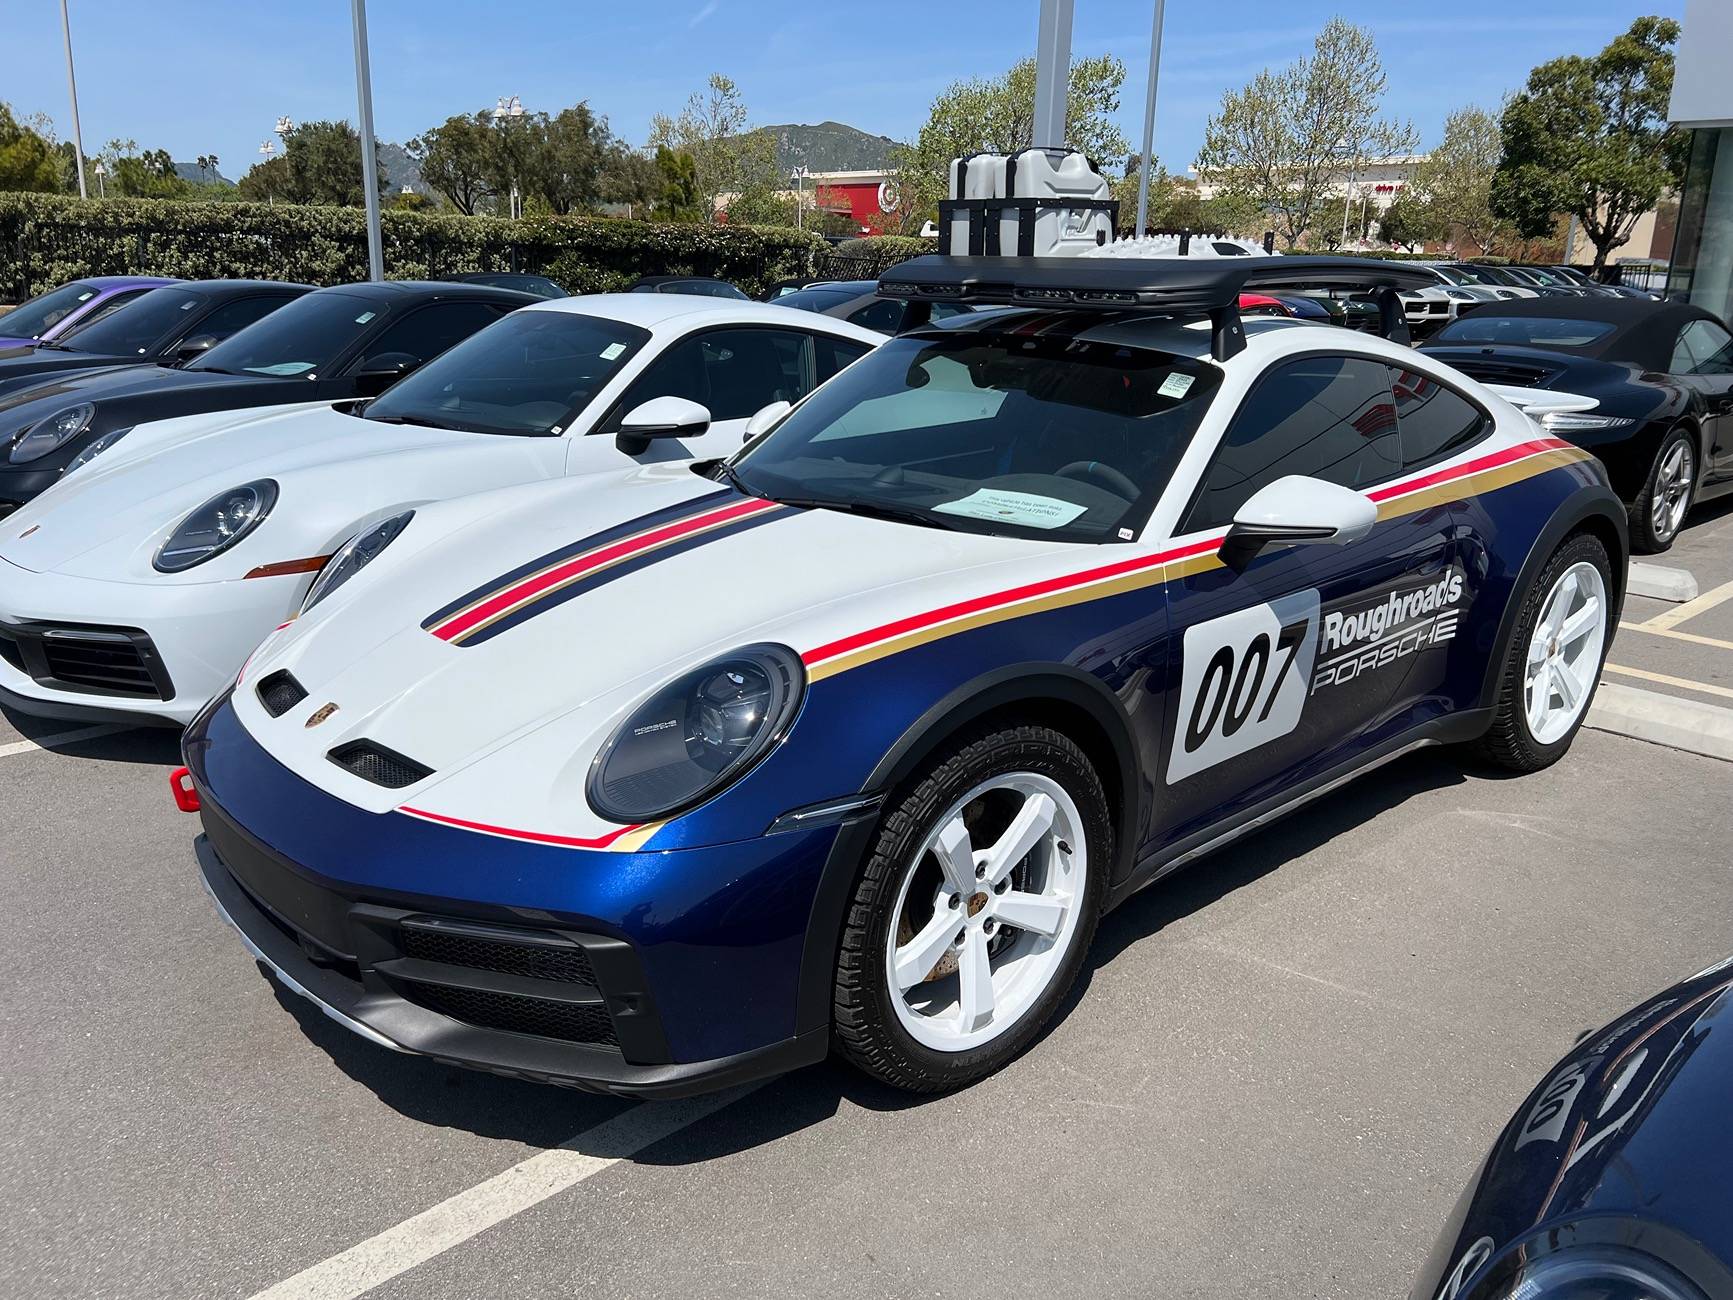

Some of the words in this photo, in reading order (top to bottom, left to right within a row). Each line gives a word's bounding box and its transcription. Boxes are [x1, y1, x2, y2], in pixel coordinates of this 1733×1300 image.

[1320, 570, 1462, 654] Roughroads
[1185, 618, 1311, 753] 007
[1311, 617, 1459, 696] PORSCHE
[634, 720, 677, 733] PORSCHE
